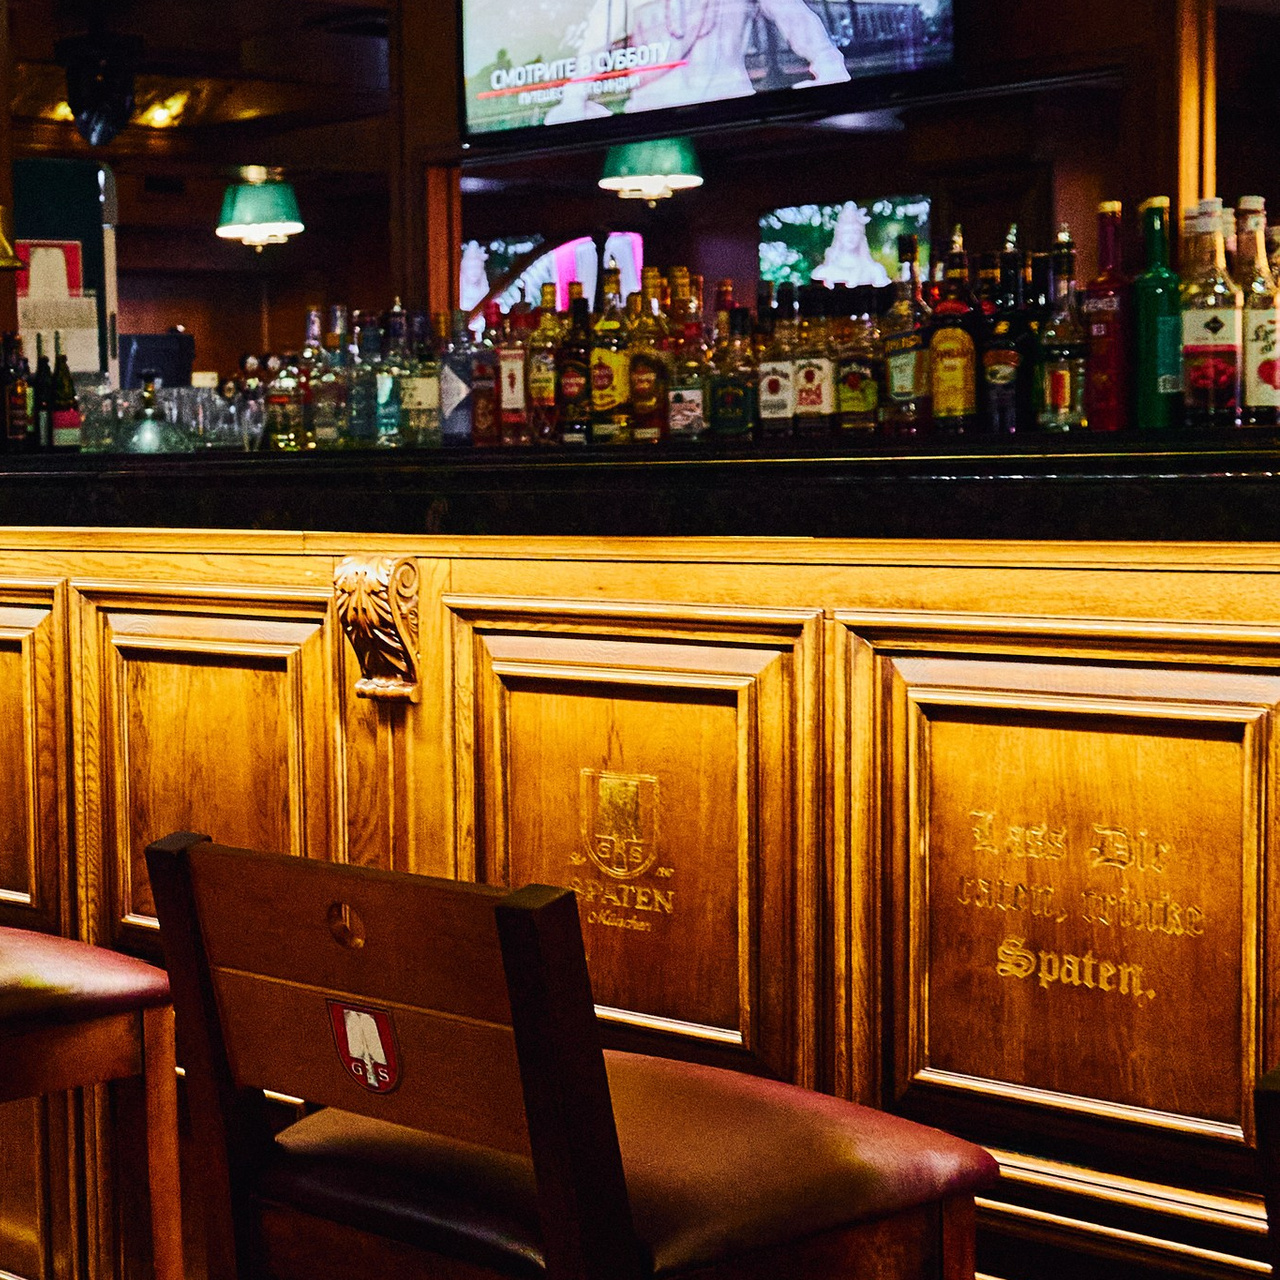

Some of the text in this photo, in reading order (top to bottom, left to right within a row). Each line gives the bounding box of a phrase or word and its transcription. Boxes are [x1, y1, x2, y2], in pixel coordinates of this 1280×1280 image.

[491, 58, 576, 90] СМОТРИТЕ
[594, 43, 670, 73] СУББОТУ
[570, 877, 675, 914] SPATEN
[996, 934, 1157, 1000] Spaten.
[351, 1062, 390, 1082] G S
